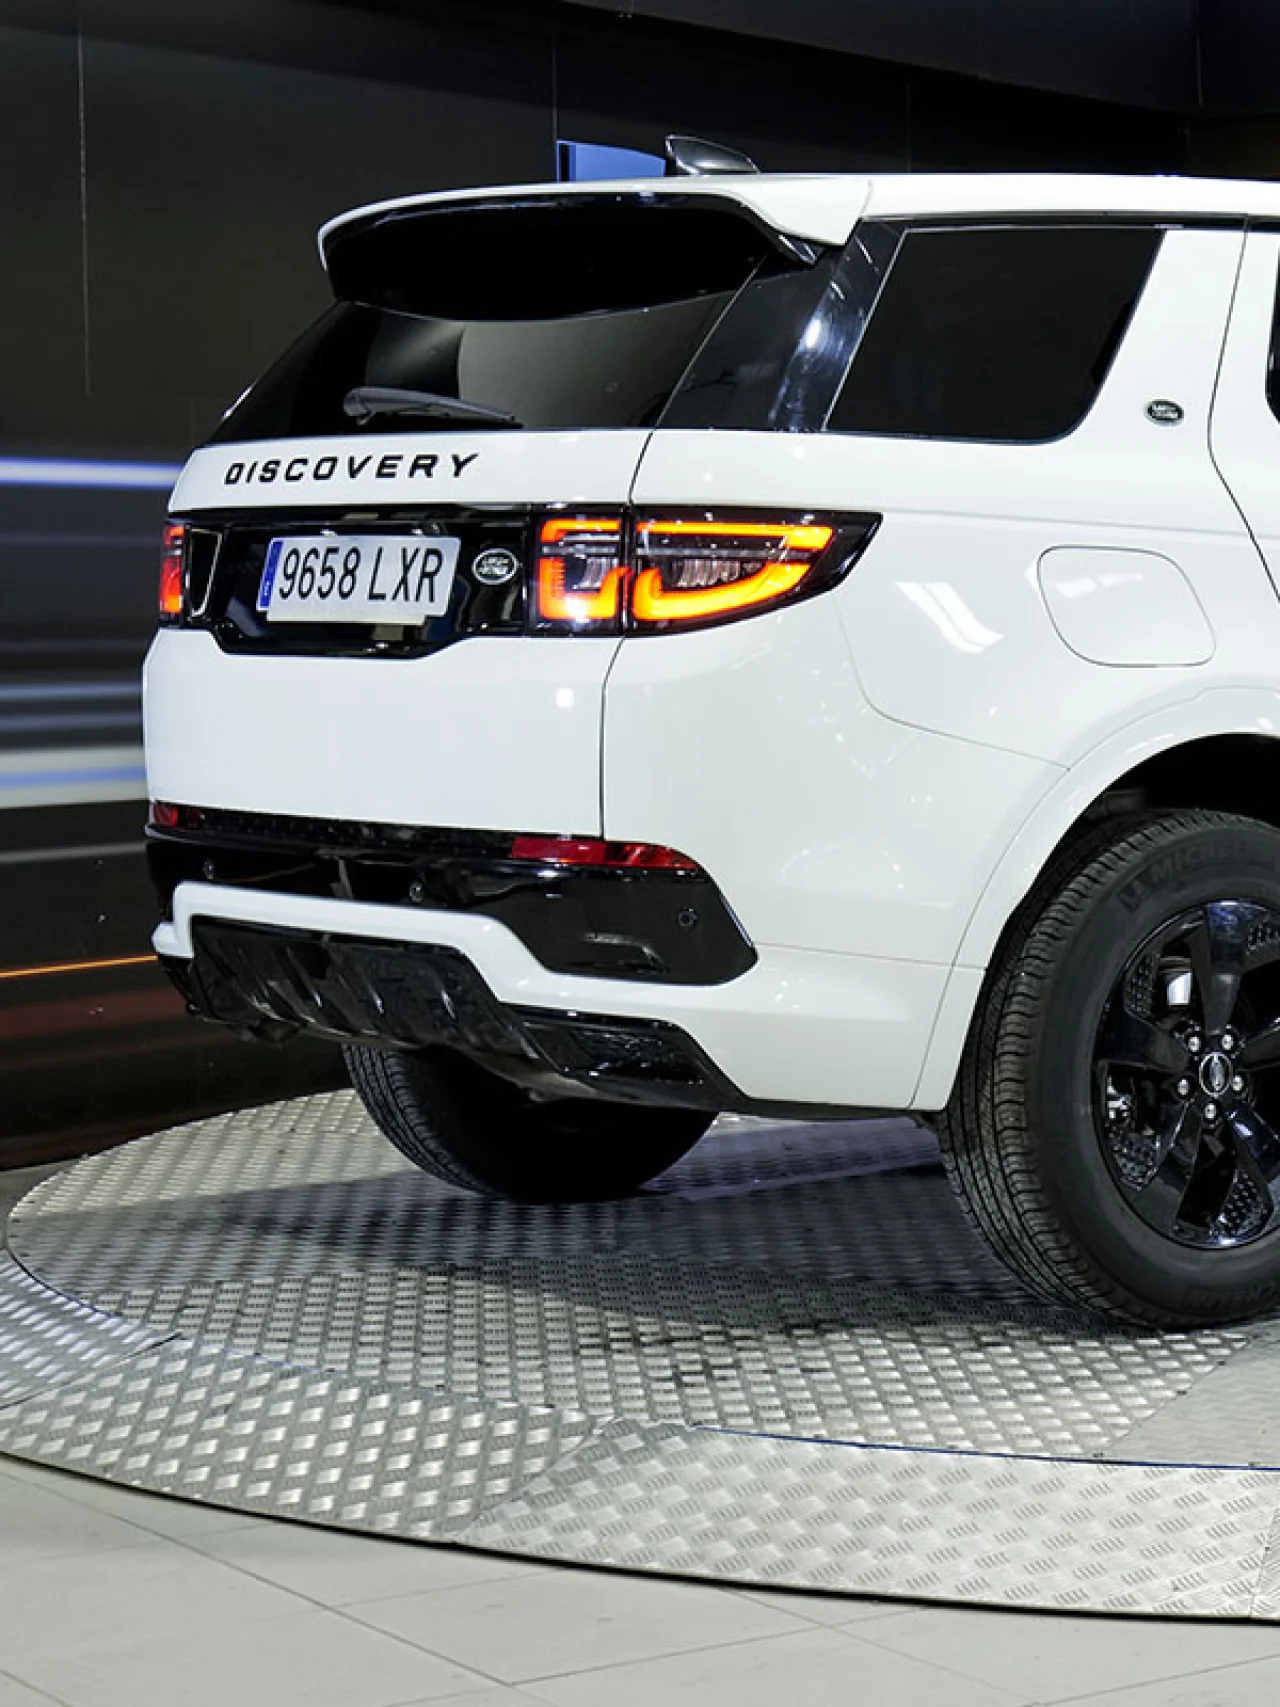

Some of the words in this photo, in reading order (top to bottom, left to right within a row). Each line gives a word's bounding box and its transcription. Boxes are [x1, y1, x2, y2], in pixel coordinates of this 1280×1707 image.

[224, 453, 478, 485] DISCOVERY
[279, 547, 361, 601] 9658
[367, 547, 443, 602] LXR
